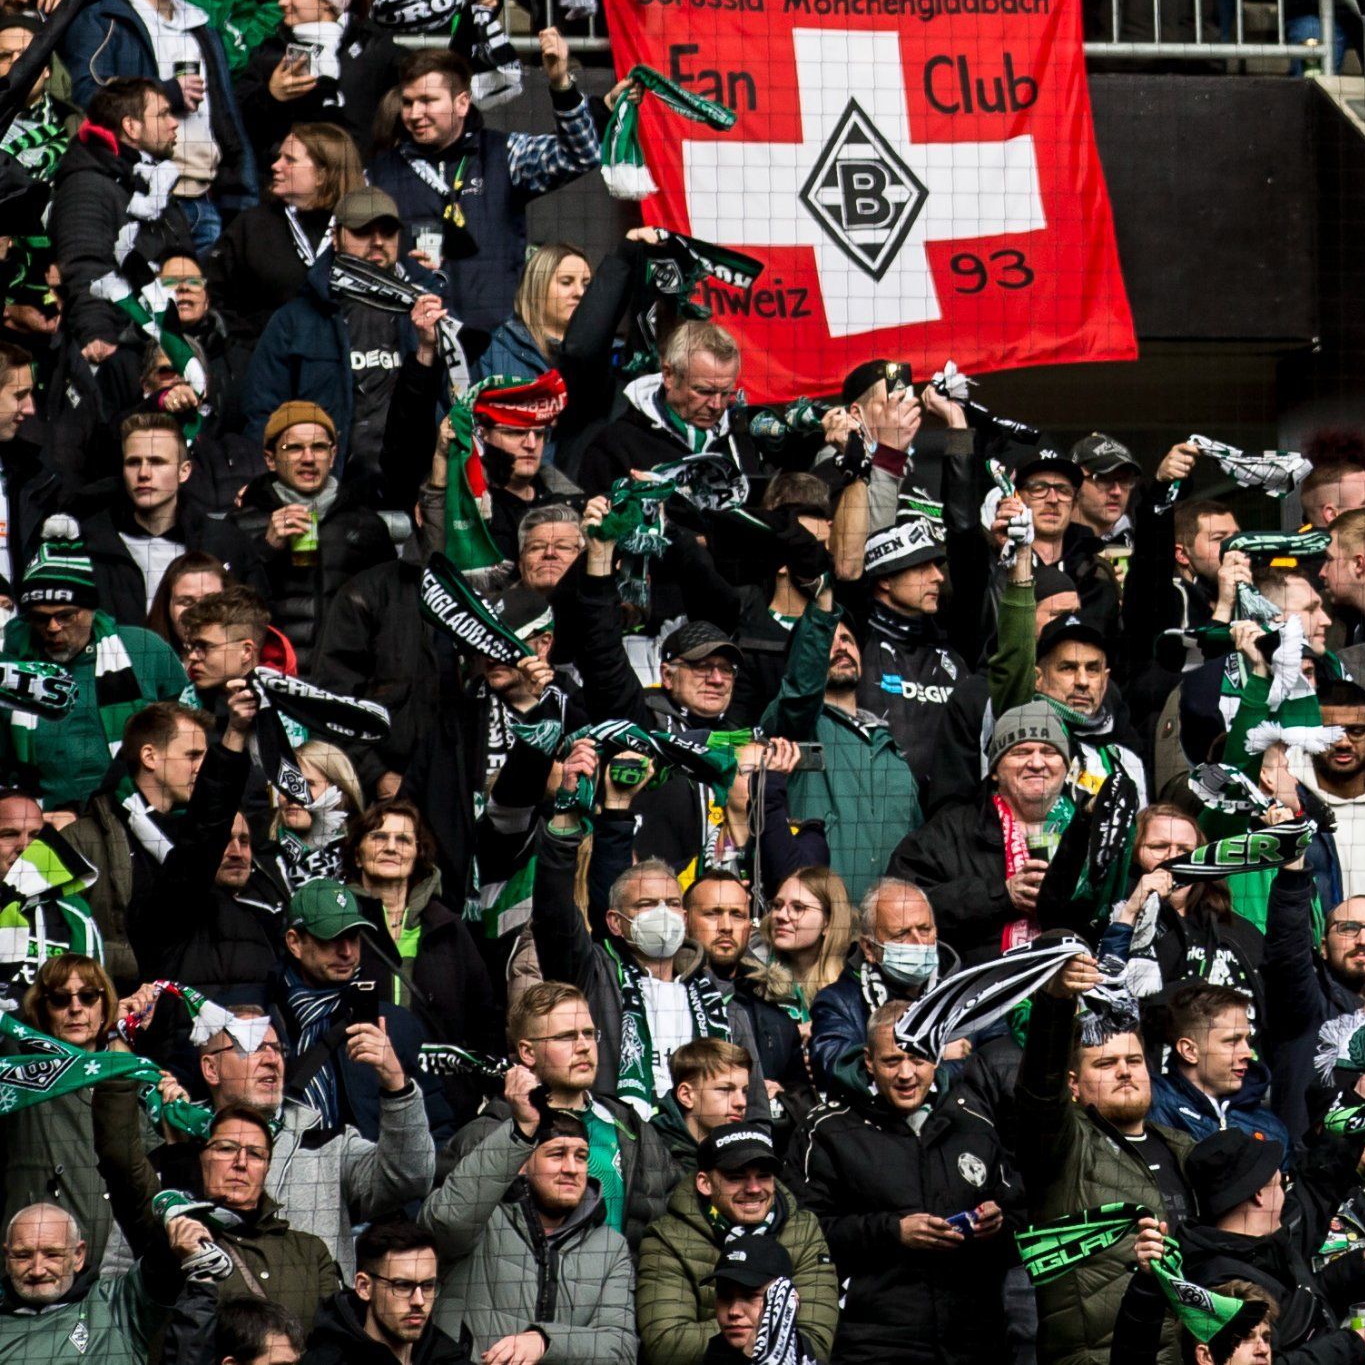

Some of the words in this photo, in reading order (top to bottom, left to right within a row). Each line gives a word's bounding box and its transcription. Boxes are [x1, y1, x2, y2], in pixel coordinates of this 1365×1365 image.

[668, 43, 758, 112] Fan
[922, 51, 1040, 115] Club
[686, 276, 813, 322] hweiz
[949, 249, 1036, 296] 93
